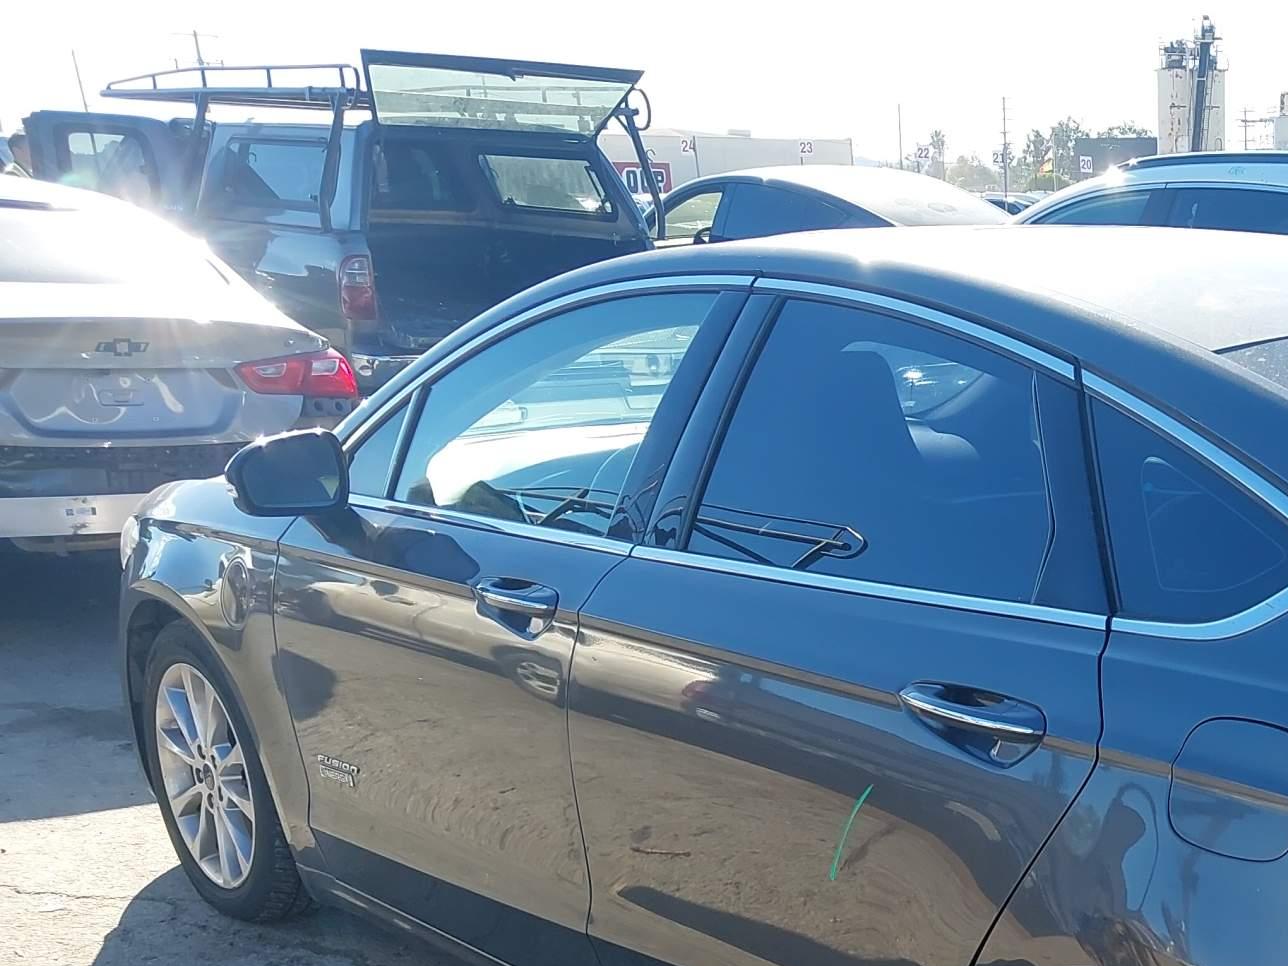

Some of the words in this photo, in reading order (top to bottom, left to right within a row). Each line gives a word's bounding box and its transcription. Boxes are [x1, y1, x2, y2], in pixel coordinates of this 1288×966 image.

[681, 140, 696, 153] 24
[800, 141, 813, 154] 23
[917, 147, 930, 159] 22
[1081, 159, 1092, 170] 20
